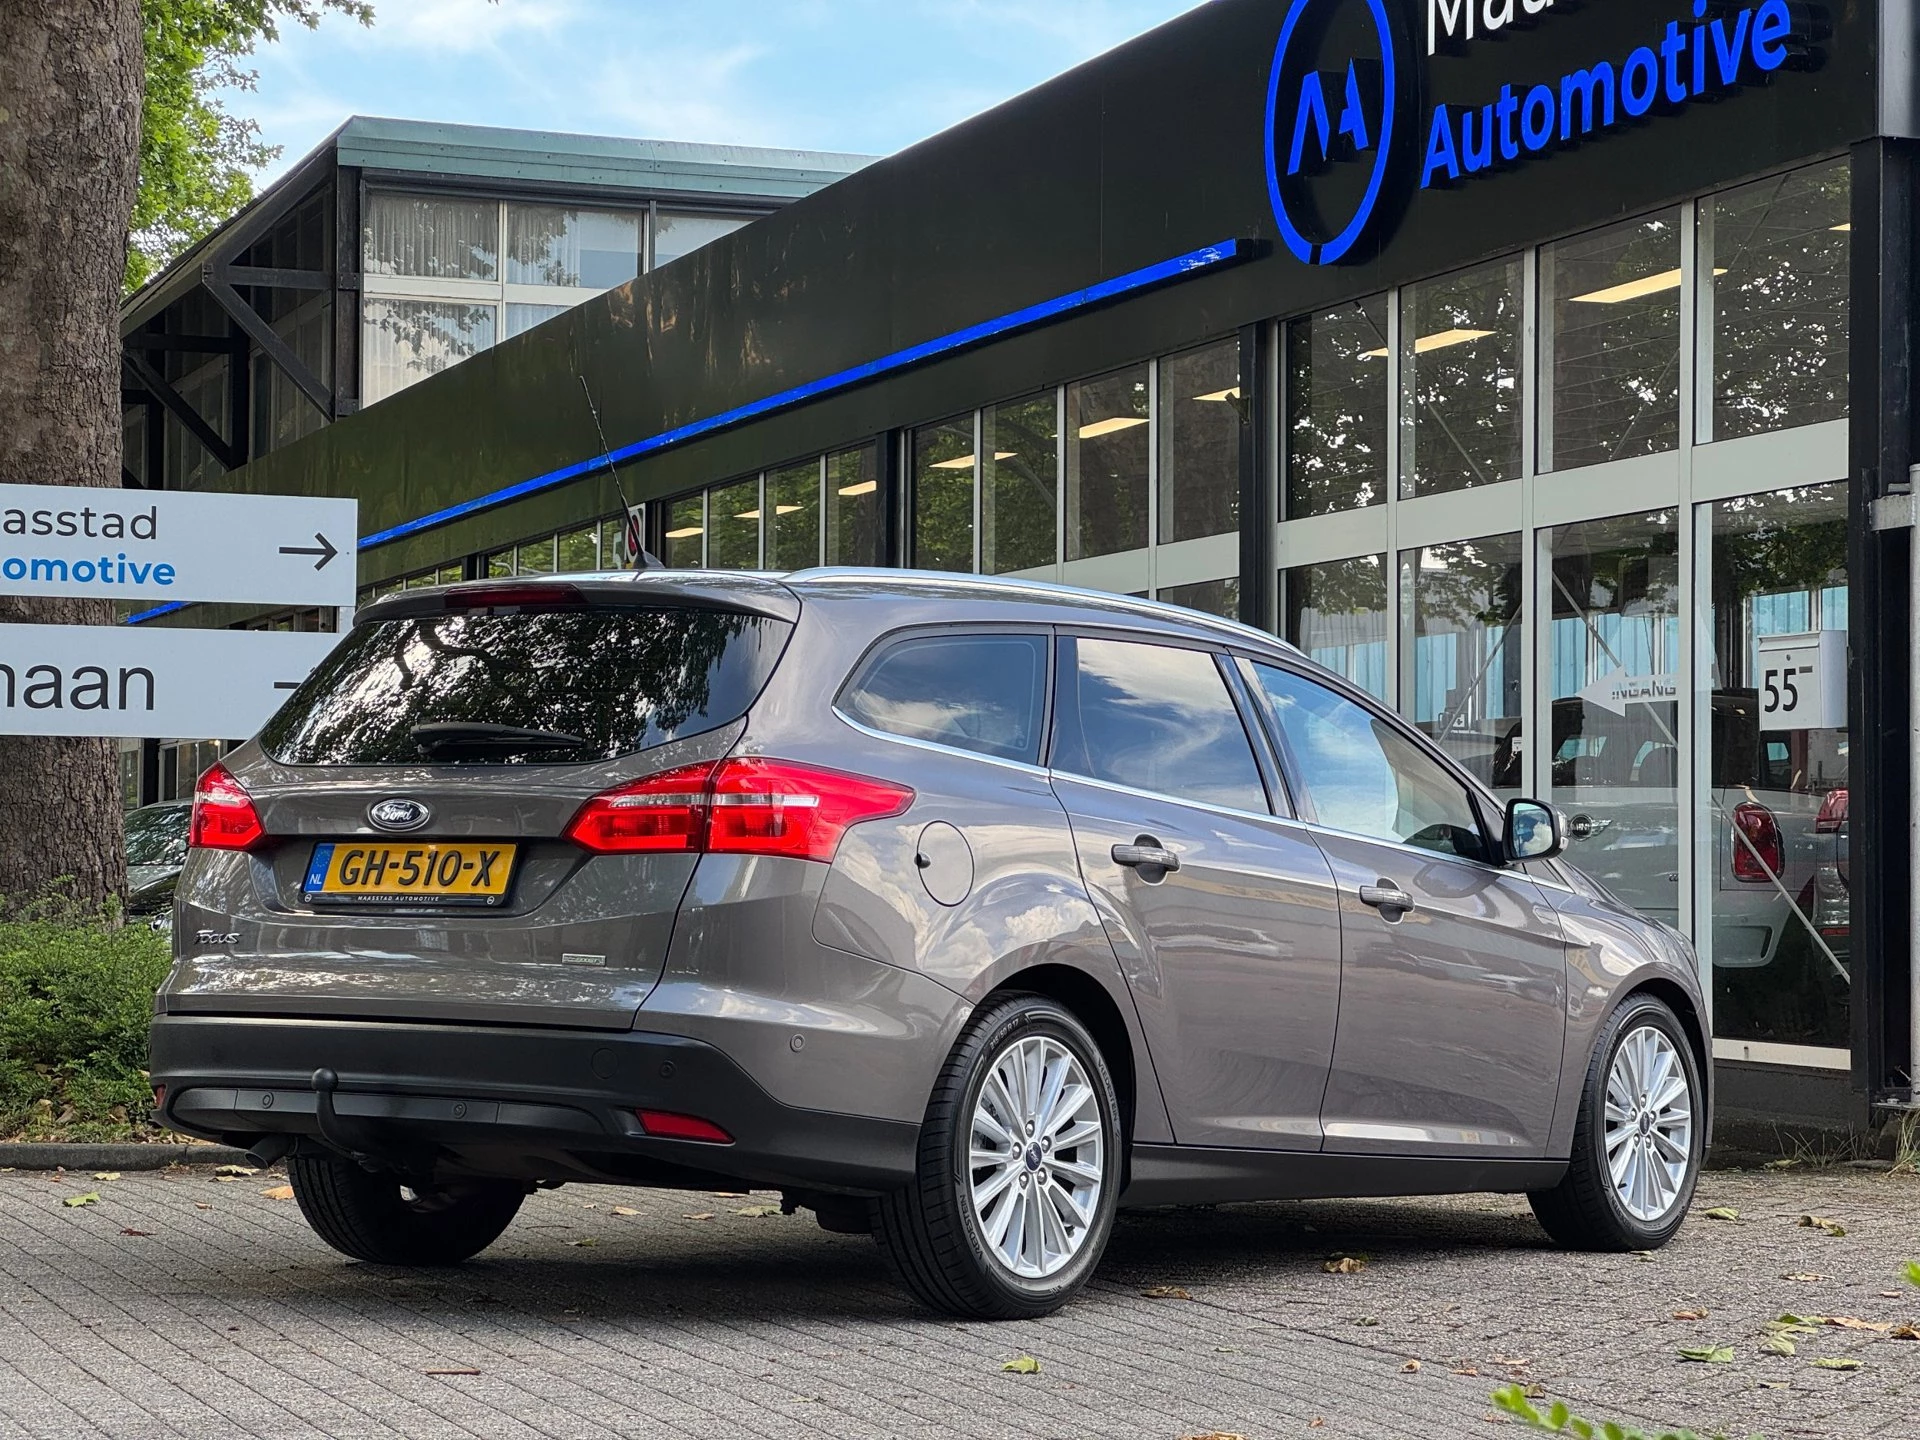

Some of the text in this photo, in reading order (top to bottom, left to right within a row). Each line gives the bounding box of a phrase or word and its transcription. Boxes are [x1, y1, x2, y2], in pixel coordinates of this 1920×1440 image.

[1427, 0, 1554, 57] Ma
[1420, 0, 1791, 190] Automotive
[2, 505, 158, 540] asstad
[1, 552, 176, 586] omotive
[1763, 668, 1798, 713] 55
[381, 803, 413, 821] Ford
[308, 873, 323, 885] NL
[339, 849, 500, 887] GH-510-X
[959, 1194, 984, 1260] VREDESTEIN
